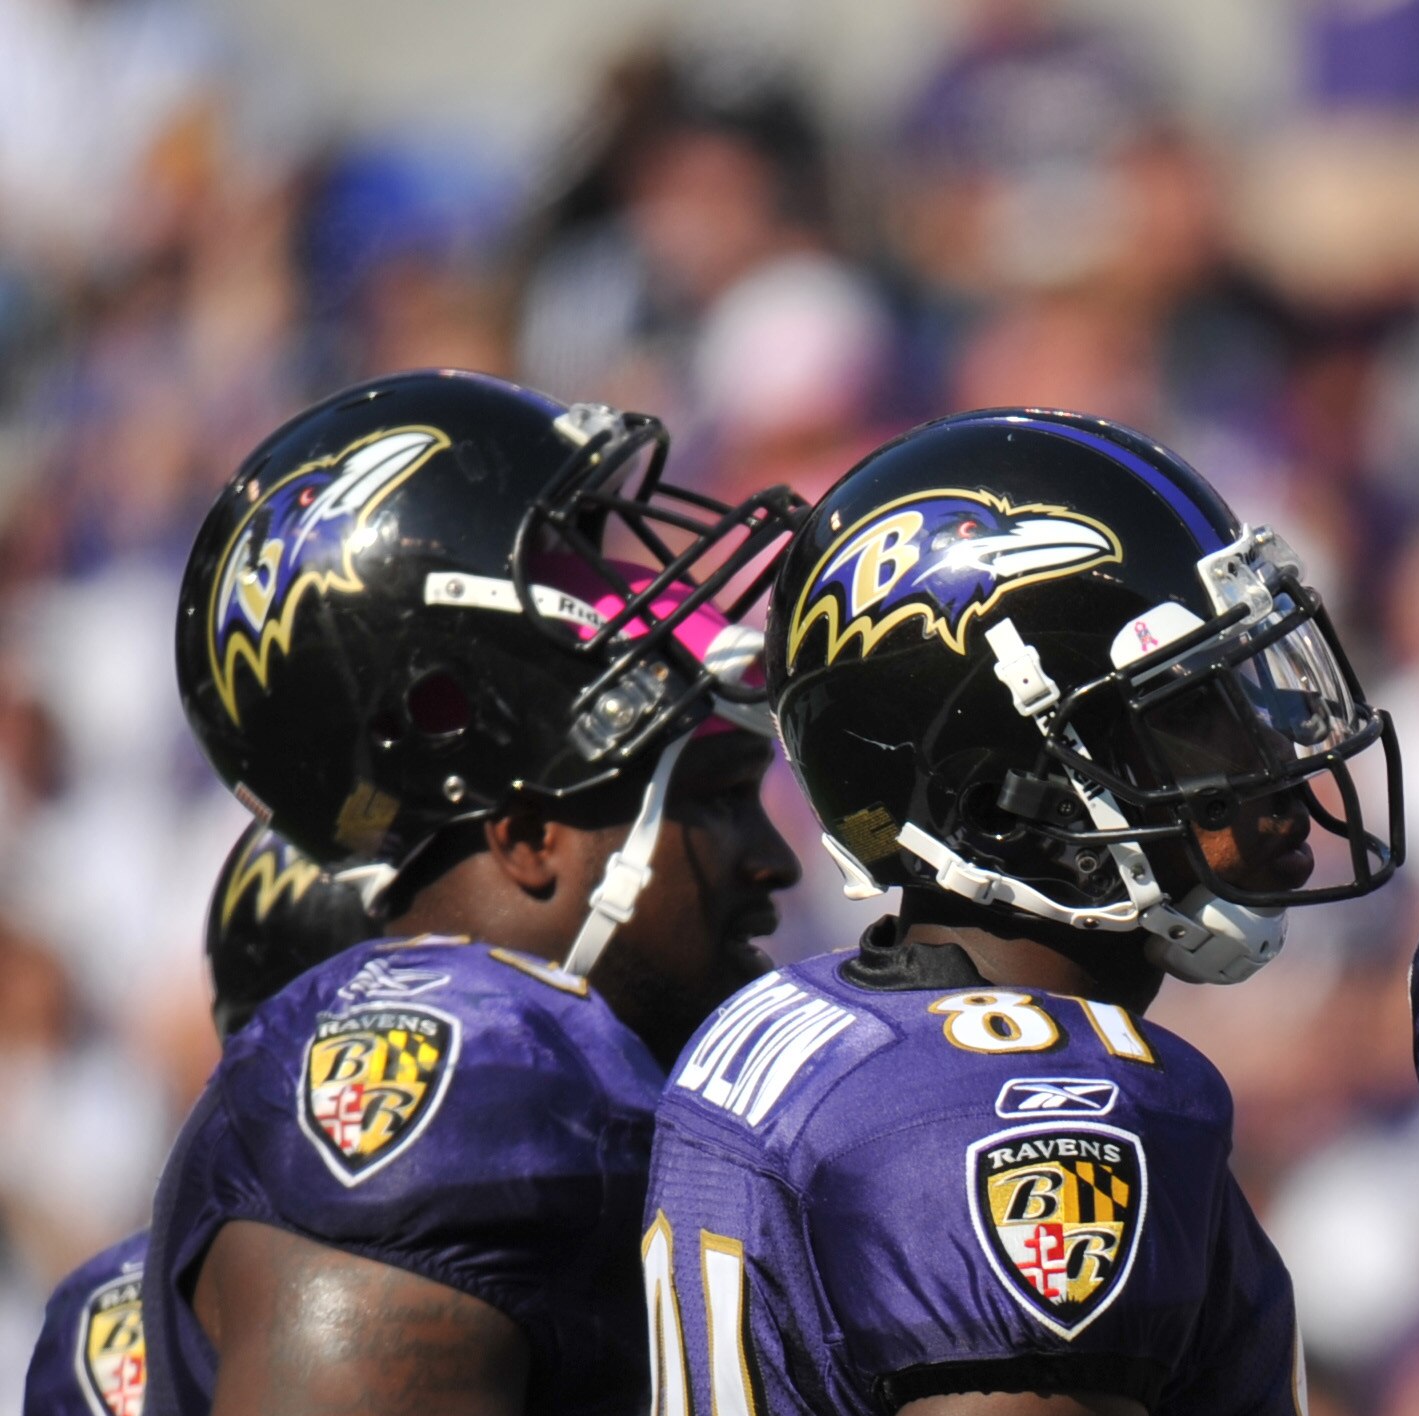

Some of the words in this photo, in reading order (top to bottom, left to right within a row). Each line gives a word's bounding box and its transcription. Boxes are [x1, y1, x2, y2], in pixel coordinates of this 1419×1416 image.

[821, 510, 924, 617] B
[319, 1013, 438, 1039] RAVENS
[927, 990, 1157, 1064] 81
[987, 1137, 1122, 1170] RAVENS
[993, 1165, 1064, 1224] B
[1062, 1226, 1119, 1283] R
